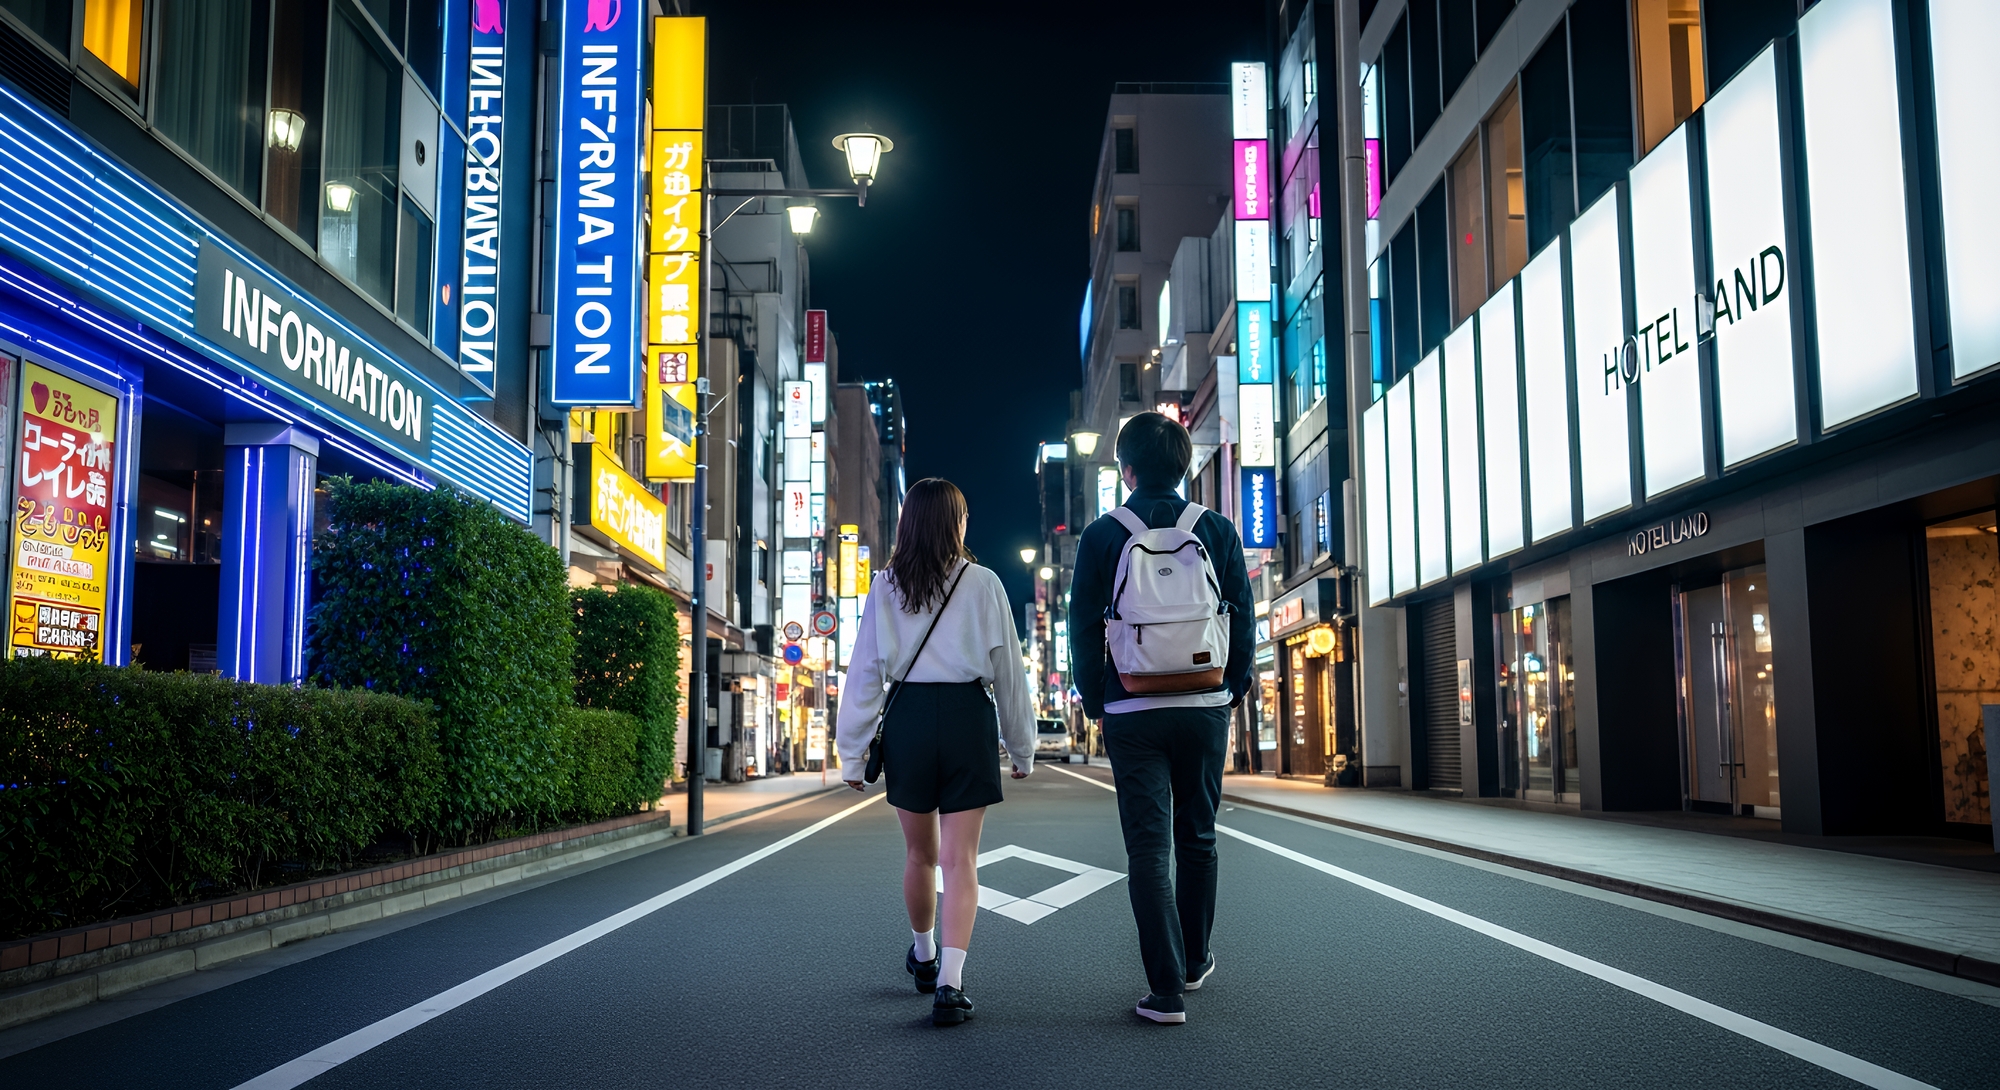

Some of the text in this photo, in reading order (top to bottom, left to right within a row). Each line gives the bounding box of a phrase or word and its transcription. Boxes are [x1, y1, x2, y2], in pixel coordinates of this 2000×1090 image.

[222, 268, 423, 442] INFORMATION
[1604, 245, 1785, 395] HOTEL LAND
